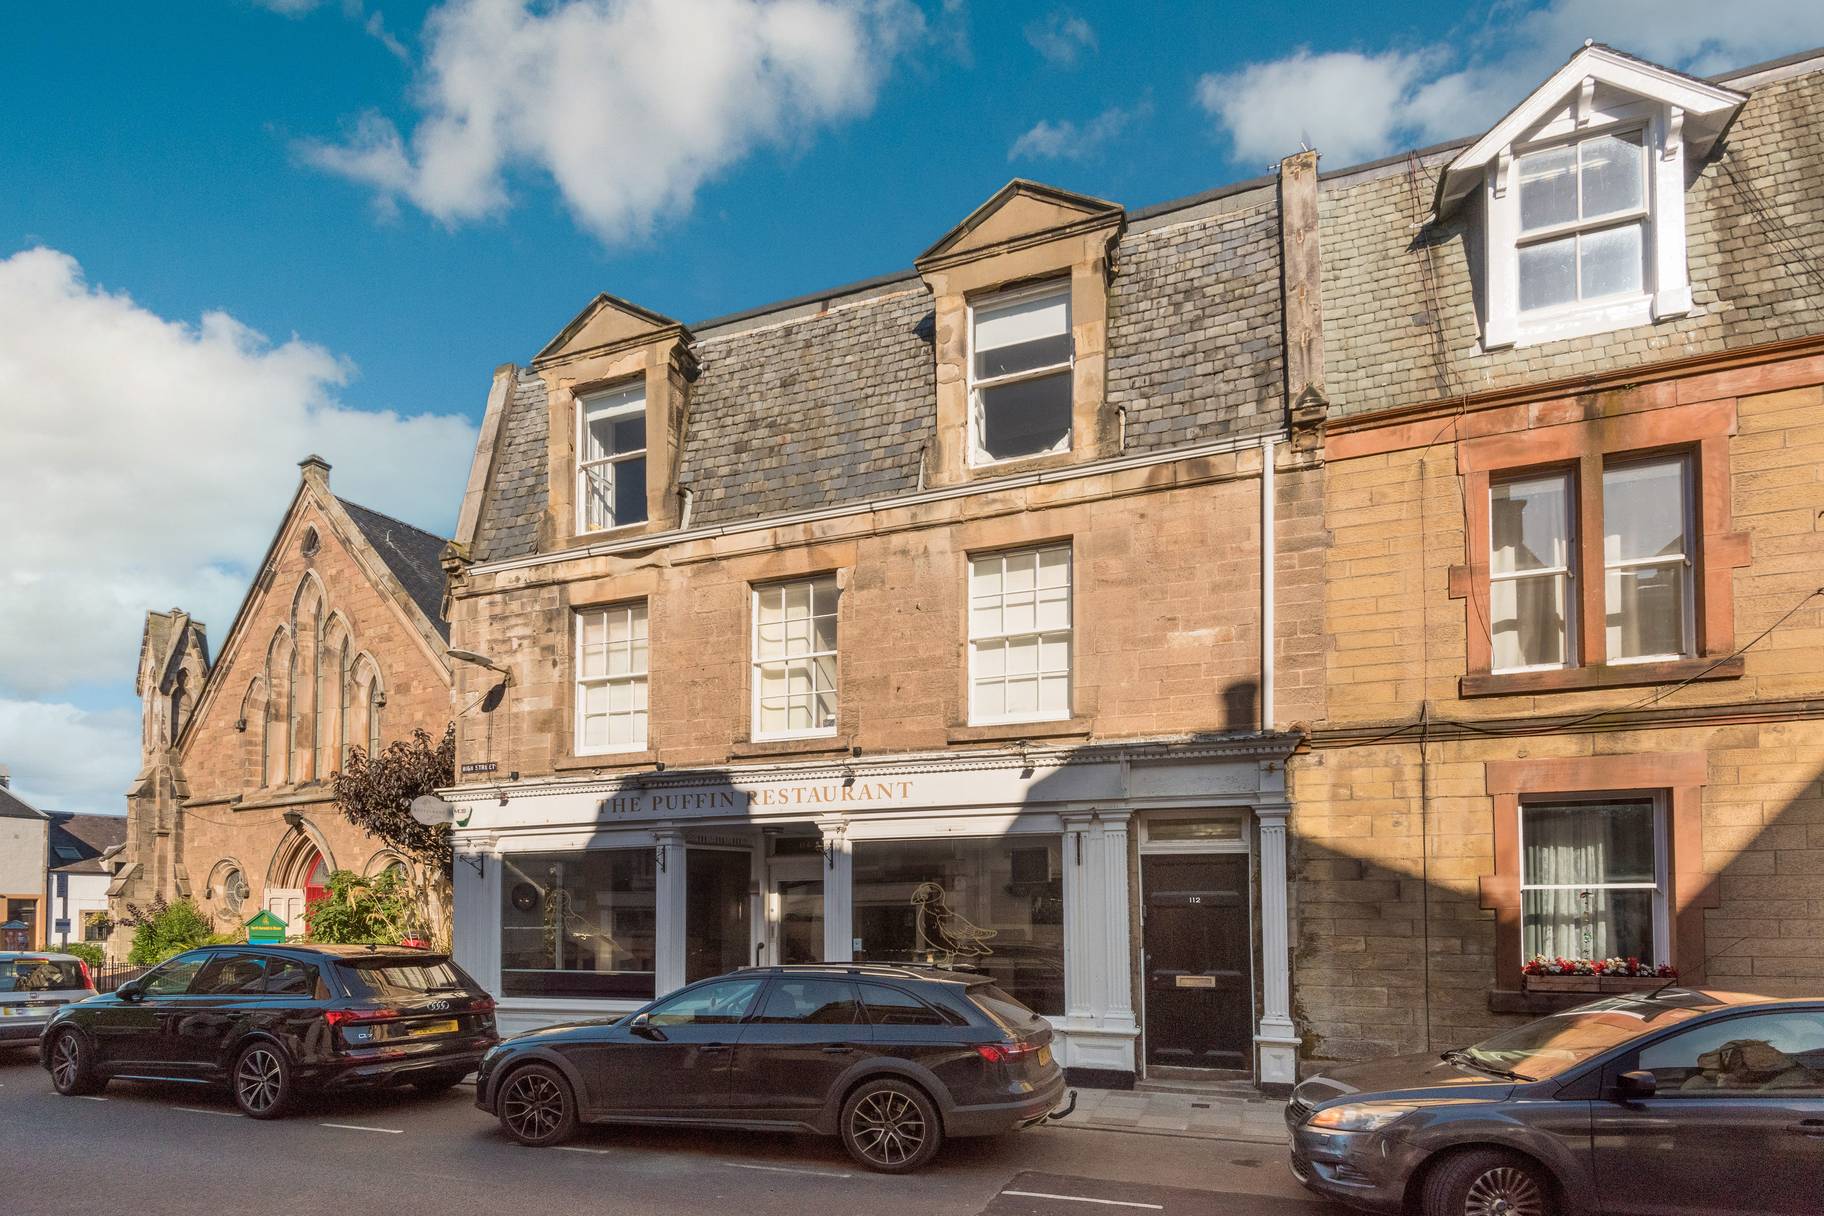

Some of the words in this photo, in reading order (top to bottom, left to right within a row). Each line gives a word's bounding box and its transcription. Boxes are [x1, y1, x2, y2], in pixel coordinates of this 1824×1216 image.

[474, 763, 496, 771] STREET
[596, 797, 641, 814] THE
[652, 791, 734, 811] PUFFIN
[746, 781, 914, 806] RESTAURANT
[1189, 896, 1201, 904] 112
